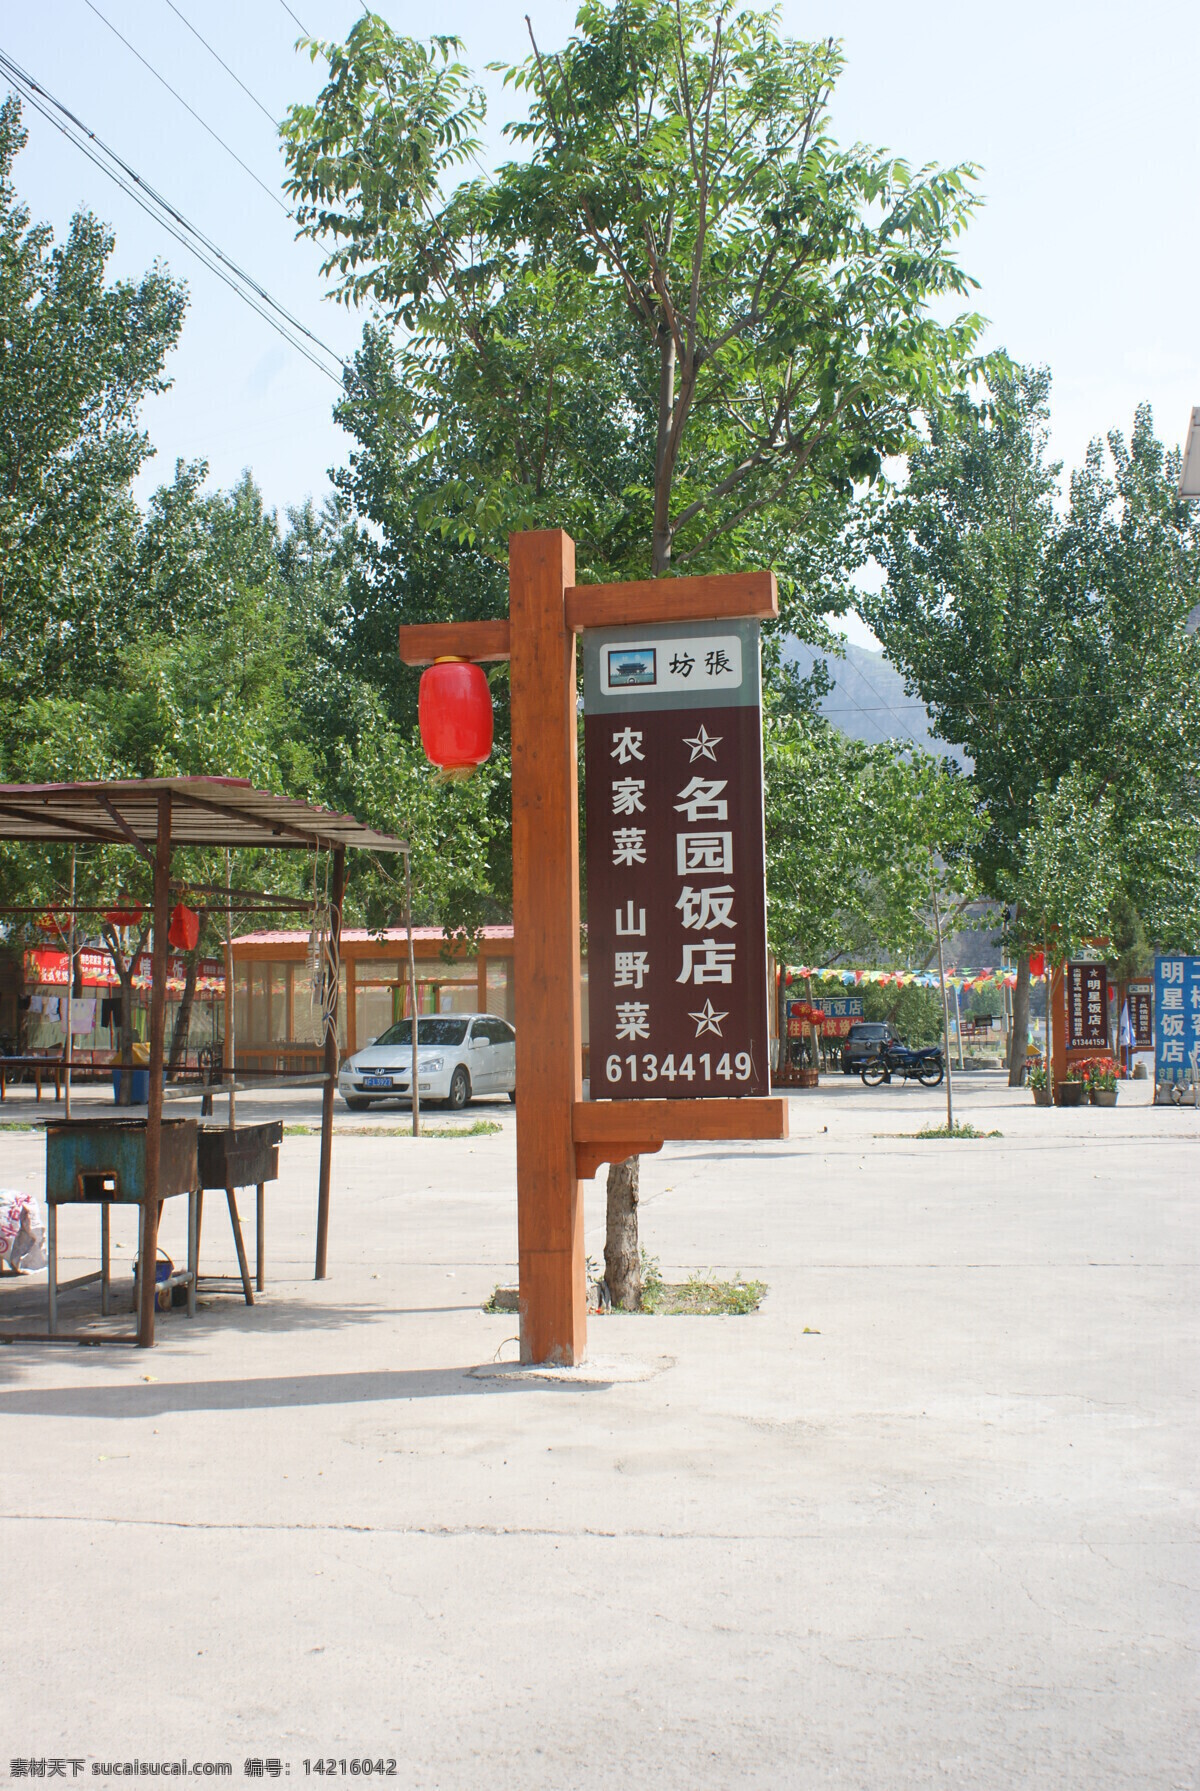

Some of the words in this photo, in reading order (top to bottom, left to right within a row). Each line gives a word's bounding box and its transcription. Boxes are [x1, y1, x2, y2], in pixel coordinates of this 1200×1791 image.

[610, 727, 647, 866] 农家菜
[674, 777, 738, 985] 名园饭店
[614, 900, 650, 1041] 山野菜
[1087, 979, 1102, 1026] 明星饭店
[1160, 961, 1185, 1063] 明星饭店
[606, 1052, 751, 1082] 61344149
